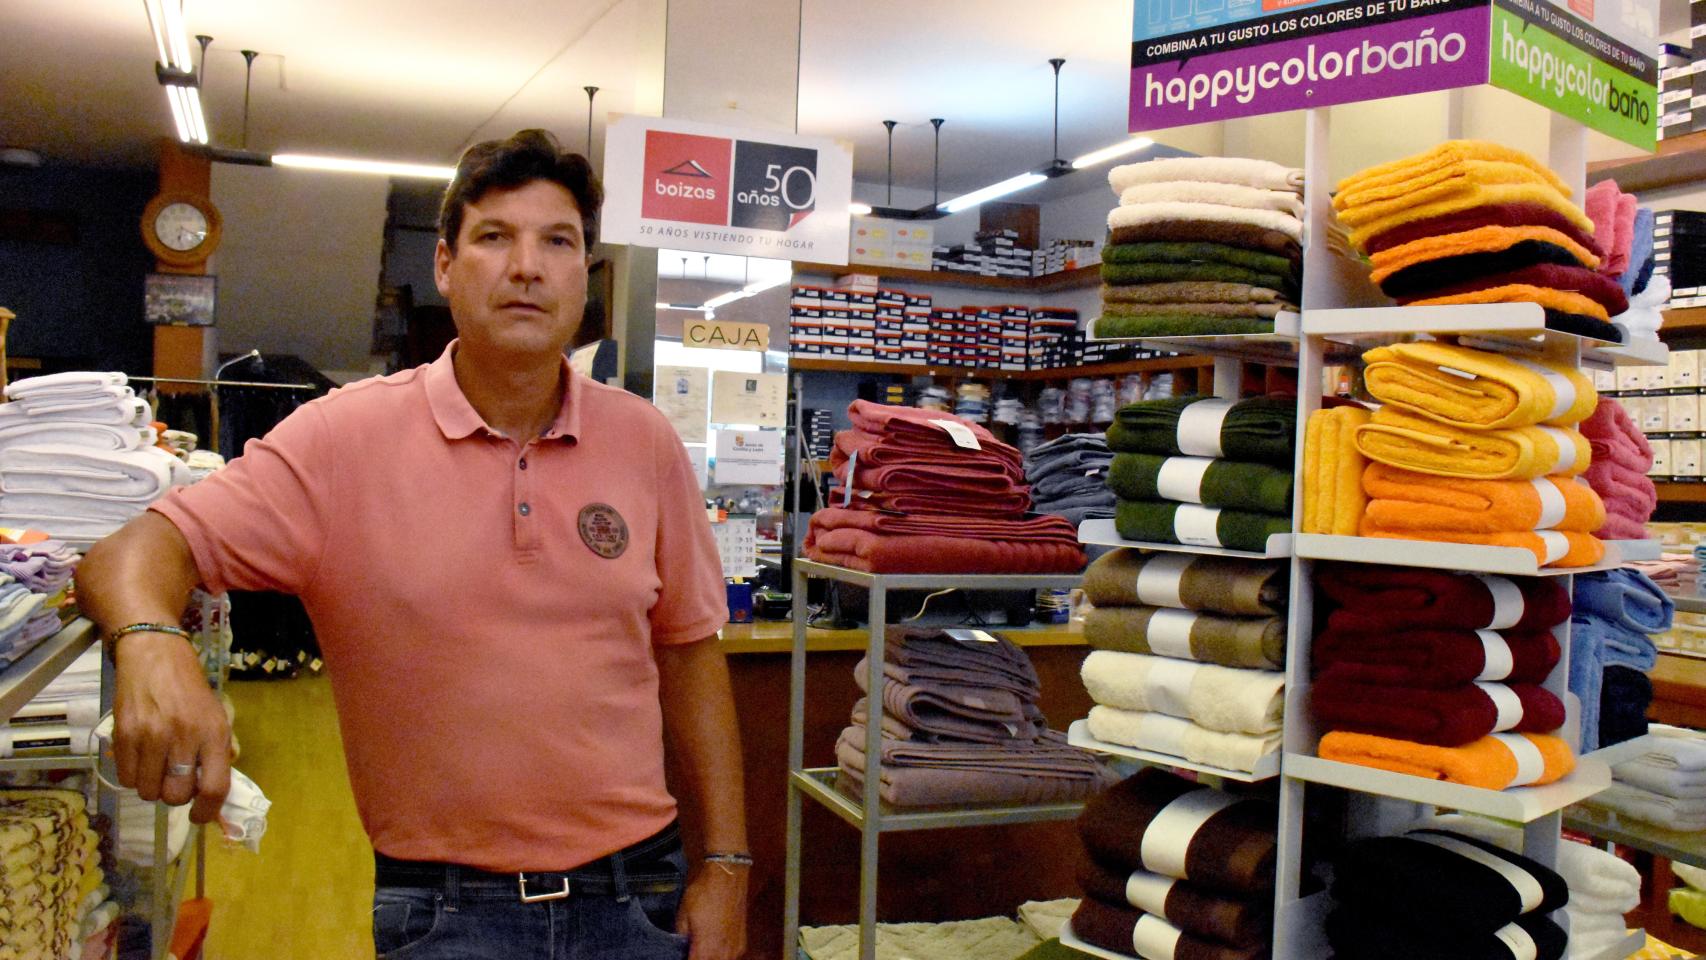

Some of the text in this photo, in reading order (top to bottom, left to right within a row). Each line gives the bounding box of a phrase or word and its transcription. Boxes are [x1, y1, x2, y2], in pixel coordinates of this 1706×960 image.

[1146, 38, 1198, 57] COMBINA
[1199, 35, 1208, 47] A
[1210, 32, 1225, 45] TU
[1228, 24, 1270, 42] GUSTO
[1272, 19, 1297, 34] LOS
[1300, 8, 1364, 28] COLORES
[1366, 3, 1385, 17] DE
[1388, 0, 1407, 13] TU
[1540, 7, 1550, 22] TU
[1550, 12, 1571, 33] GUSTO
[1571, 24, 1584, 41] LOS
[1584, 31, 1611, 56] COLORES
[1611, 47, 1620, 60] DE
[1620, 50, 1629, 64] TU
[1629, 55, 1646, 72] BAÑO
[655, 178, 716, 200] boizas
[736, 190, 780, 207] años
[764, 164, 816, 210] 50
[639, 225, 814, 249] 50 AÑOS VISTIENDO TU HOGAR
[688, 324, 762, 346] CAJA
